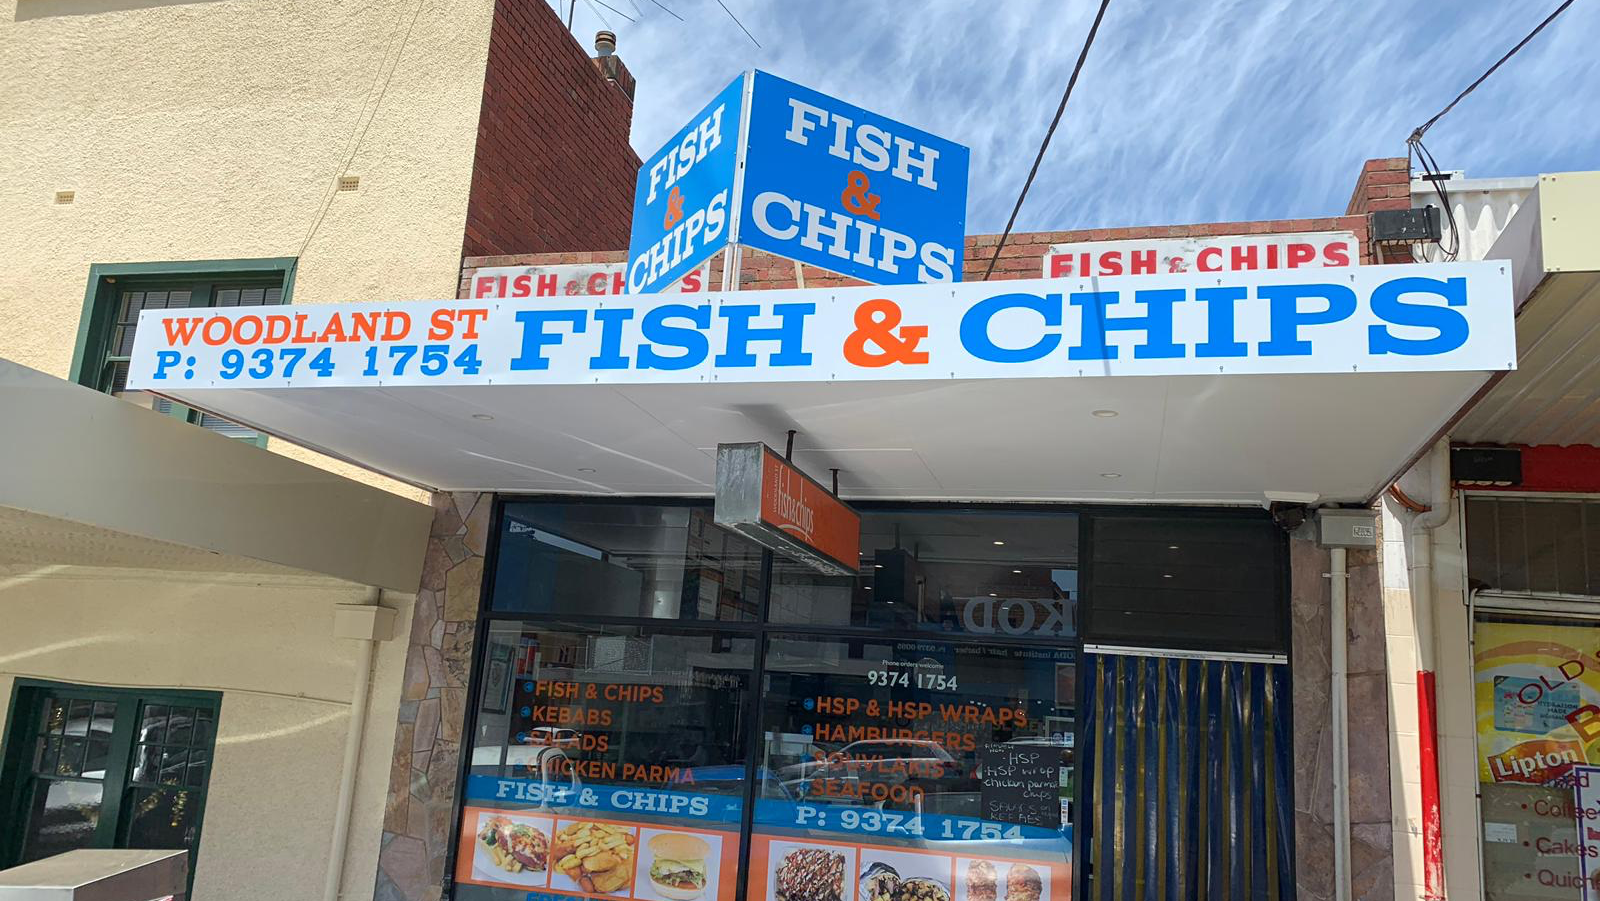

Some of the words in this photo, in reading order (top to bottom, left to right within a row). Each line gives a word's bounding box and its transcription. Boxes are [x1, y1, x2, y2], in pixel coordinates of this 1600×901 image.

[646, 103, 725, 206] FISH
[785, 98, 940, 190] FISH
[663, 185, 685, 230] &
[841, 170, 880, 220] &
[628, 188, 727, 294] CHIPS
[752, 191, 955, 283] CHIPS
[1051, 250, 1156, 278] FISH
[1196, 241, 1350, 272] CHIPS
[475, 274, 557, 299] FISH
[586, 270, 702, 296] CHS
[162, 312, 412, 347] WOODLAND
[428, 308, 488, 340] ST
[510, 302, 816, 371] FISH
[842, 299, 929, 367] &
[959, 276, 1469, 363] CHIPS
[152, 350, 196, 380] P:
[219, 347, 335, 380] 9374
[362, 344, 482, 376] 1754
[881, 659, 900, 667] Phone
[535, 680, 579, 699] FISH
[585, 683, 598, 699] &
[604, 684, 665, 703] CHIPS
[867, 670, 910, 688] 9374
[917, 673, 958, 691] 1754
[1518, 660, 1584, 705] OLD
[532, 706, 613, 726] KEBABS
[816, 696, 859, 716] HSP
[865, 699, 880, 717] &
[888, 701, 932, 720] HSP
[940, 703, 1029, 728] WRAPS
[530, 730, 609, 753] SALADS
[815, 723, 977, 752] HAMBURGERS
[526, 756, 616, 780] CHICKEN
[623, 763, 695, 785] PARMA
[987, 766, 1016, 777] HSP
[1009, 752, 1040, 765] HSP
[1496, 748, 1578, 778] Lipton
[496, 780, 568, 803] FISH
[579, 787, 599, 806] &
[610, 791, 709, 815] CHIPS
[811, 778, 925, 804] SEAFOOD
[796, 806, 826, 825] P:
[840, 810, 925, 835] 9374
[942, 819, 1024, 845] 1754
[1536, 837, 1598, 858] Cakes
